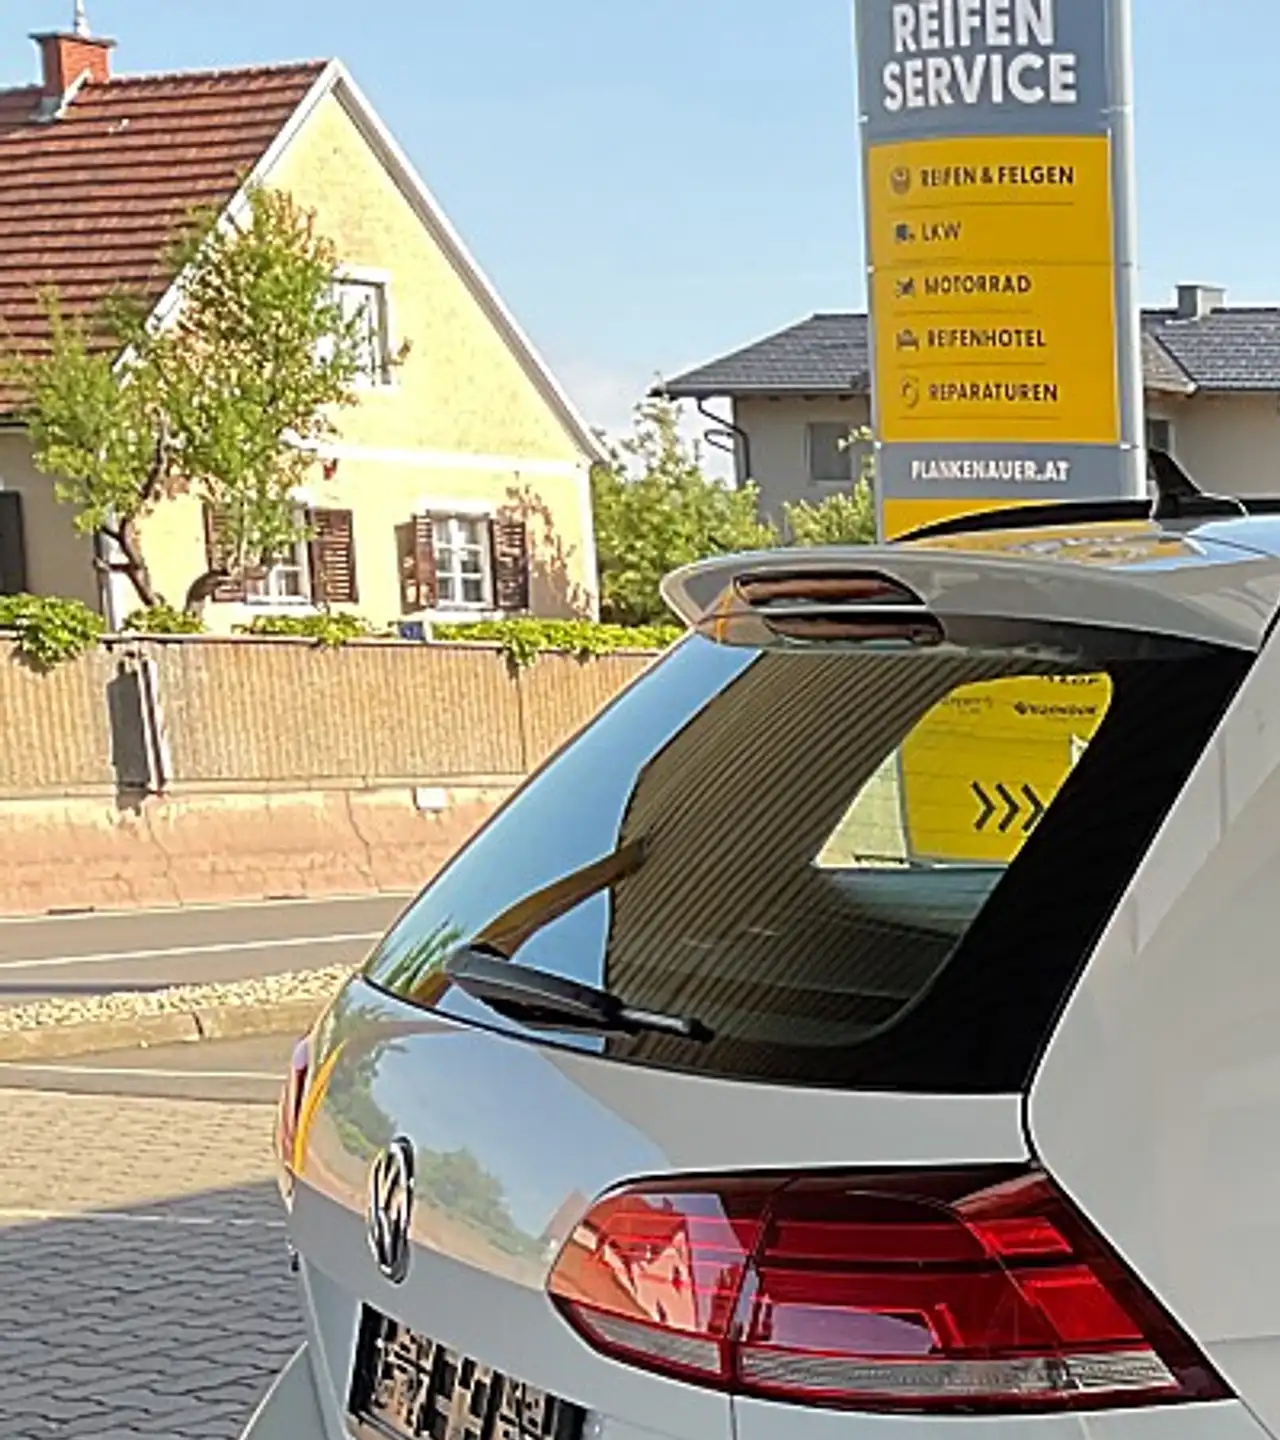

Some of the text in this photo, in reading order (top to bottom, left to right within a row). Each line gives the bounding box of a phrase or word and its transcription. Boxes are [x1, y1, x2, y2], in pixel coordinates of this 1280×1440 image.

[893, 0, 1053, 52] REIFEN
[883, 53, 1077, 111] SERVICE
[920, 165, 1074, 187] REIFEN & FELGEN
[921, 221, 961, 242] LKW
[925, 275, 1032, 295] MOTORRAD
[927, 329, 1047, 348] REIFENHOTEL
[928, 383, 1058, 402] REPARATUREN
